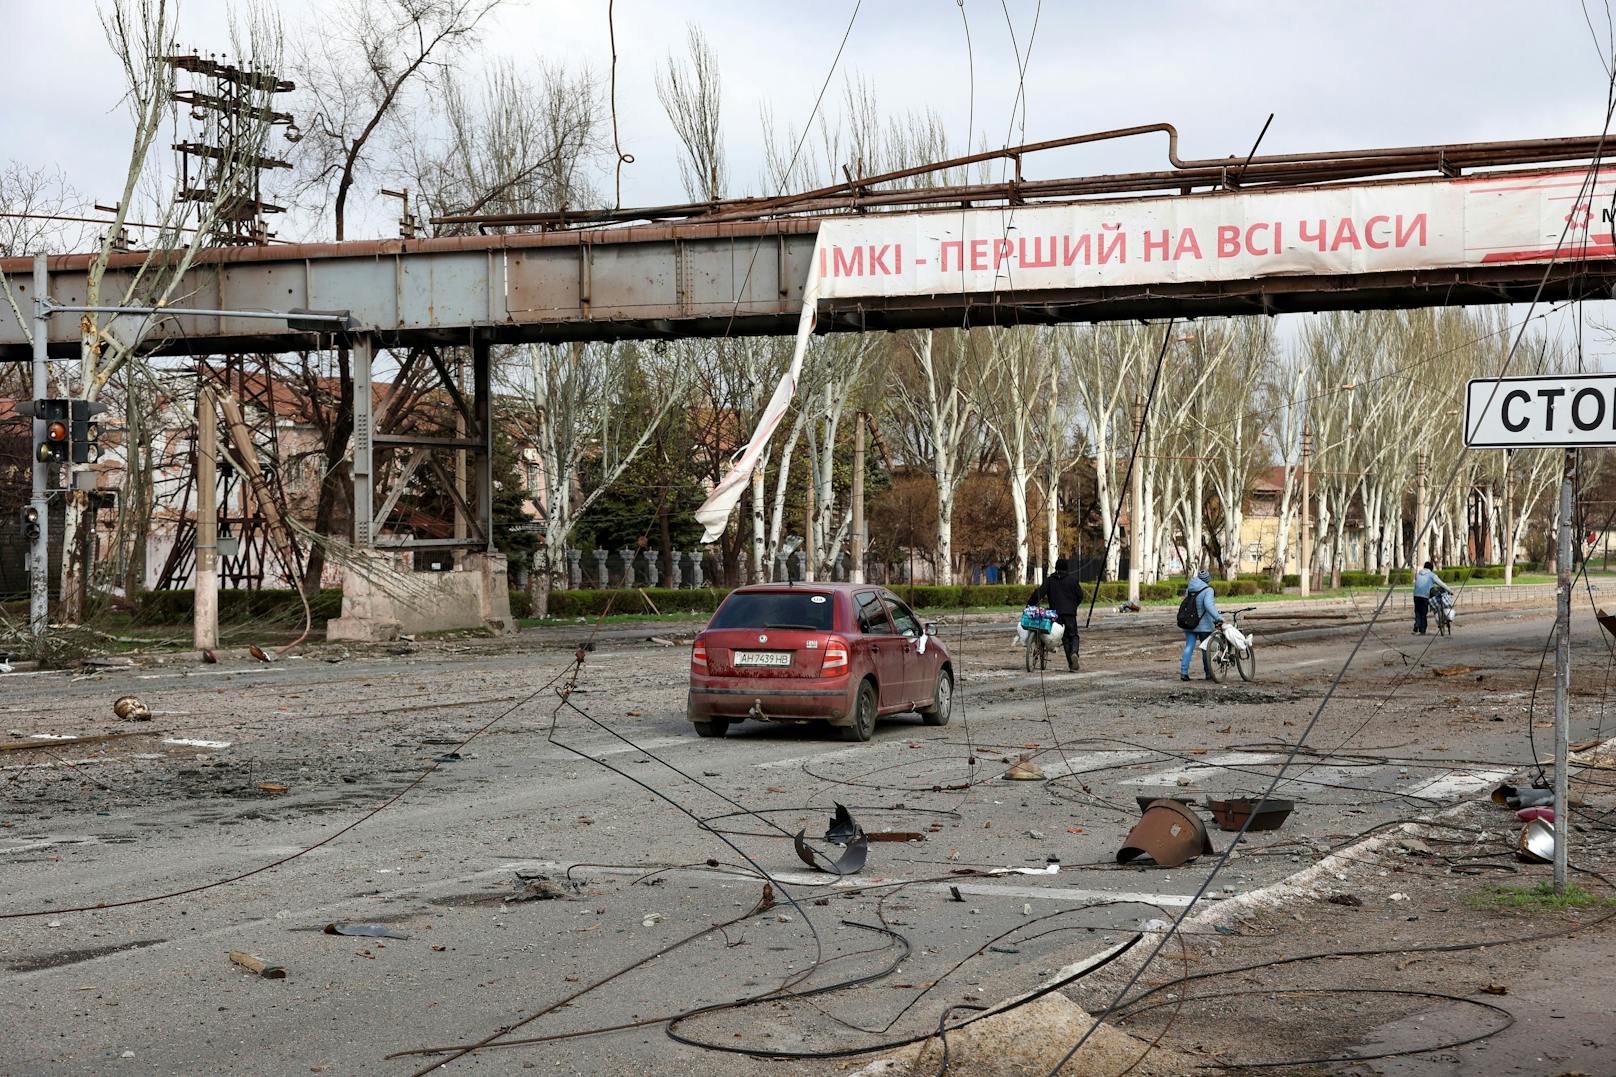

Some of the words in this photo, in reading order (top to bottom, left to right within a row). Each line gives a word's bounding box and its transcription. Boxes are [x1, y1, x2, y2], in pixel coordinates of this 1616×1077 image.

[940, 222, 1127, 273] ПЕРШИЙ
[1143, 227, 1203, 262] НА
[1217, 222, 1282, 258] ВСІ
[1299, 213, 1428, 252] ЧАСИ
[1501, 387, 1616, 433] СТО
